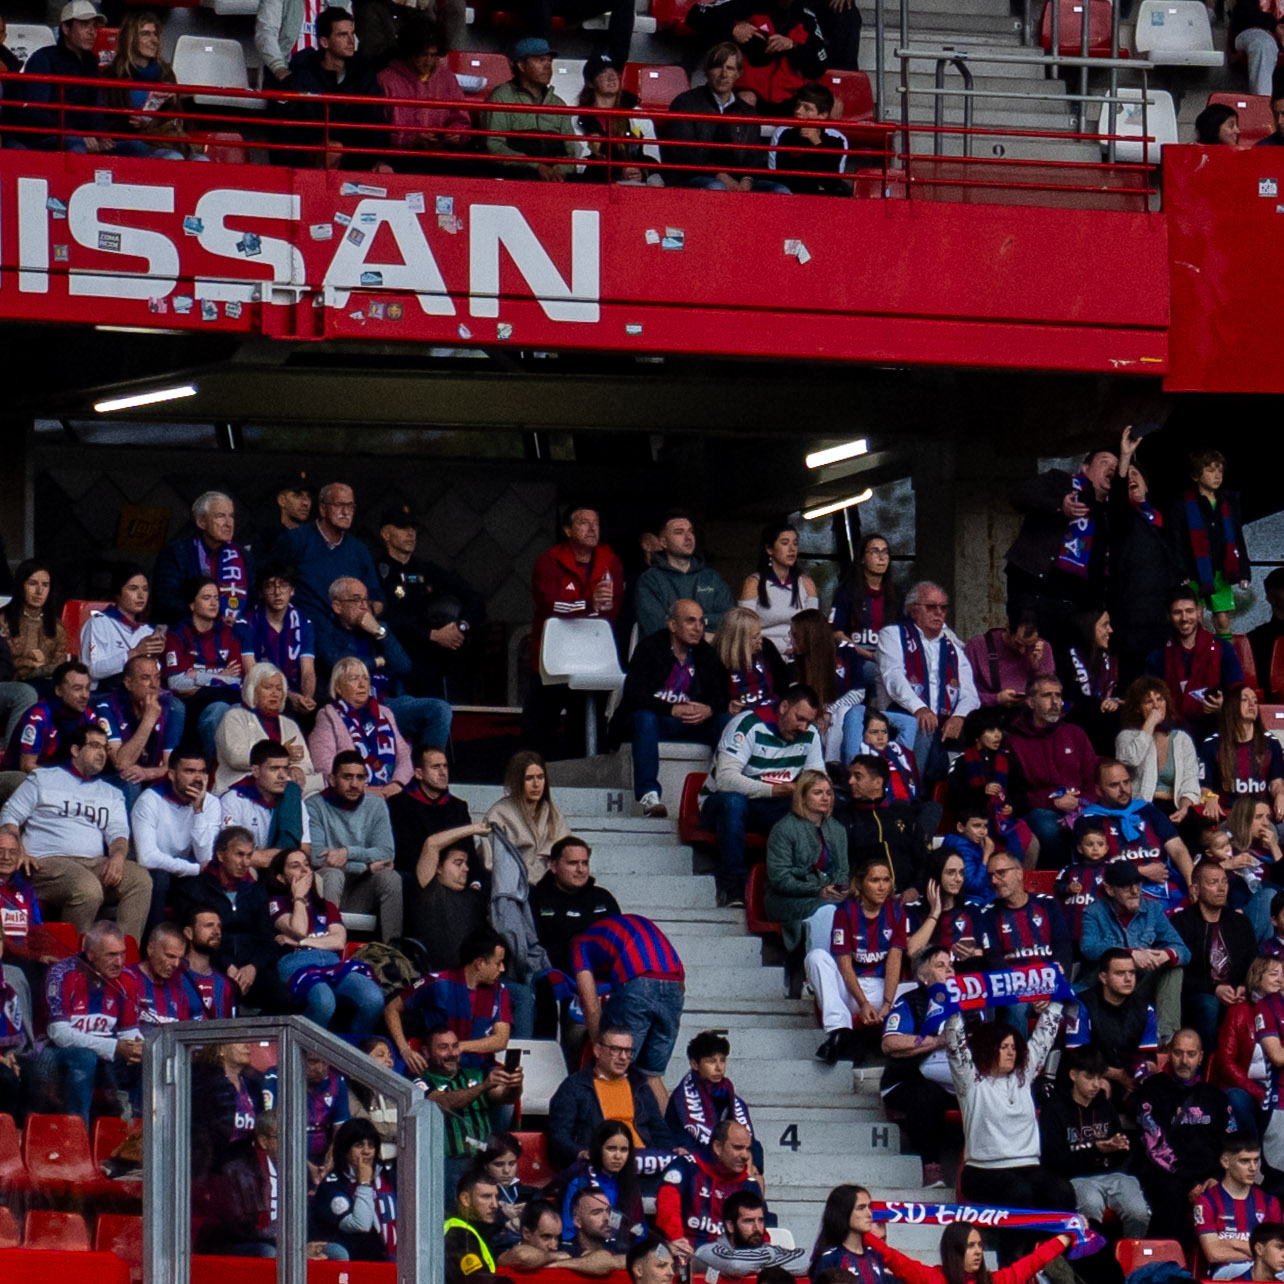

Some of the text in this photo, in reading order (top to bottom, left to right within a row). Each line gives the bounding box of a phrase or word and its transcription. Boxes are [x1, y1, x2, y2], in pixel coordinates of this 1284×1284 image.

[0, 177, 600, 322] ISSAN
[988, 964, 1057, 997] EIBAR
[779, 1124, 801, 1150] 4
[885, 1201, 1010, 1228] SD Eibar
